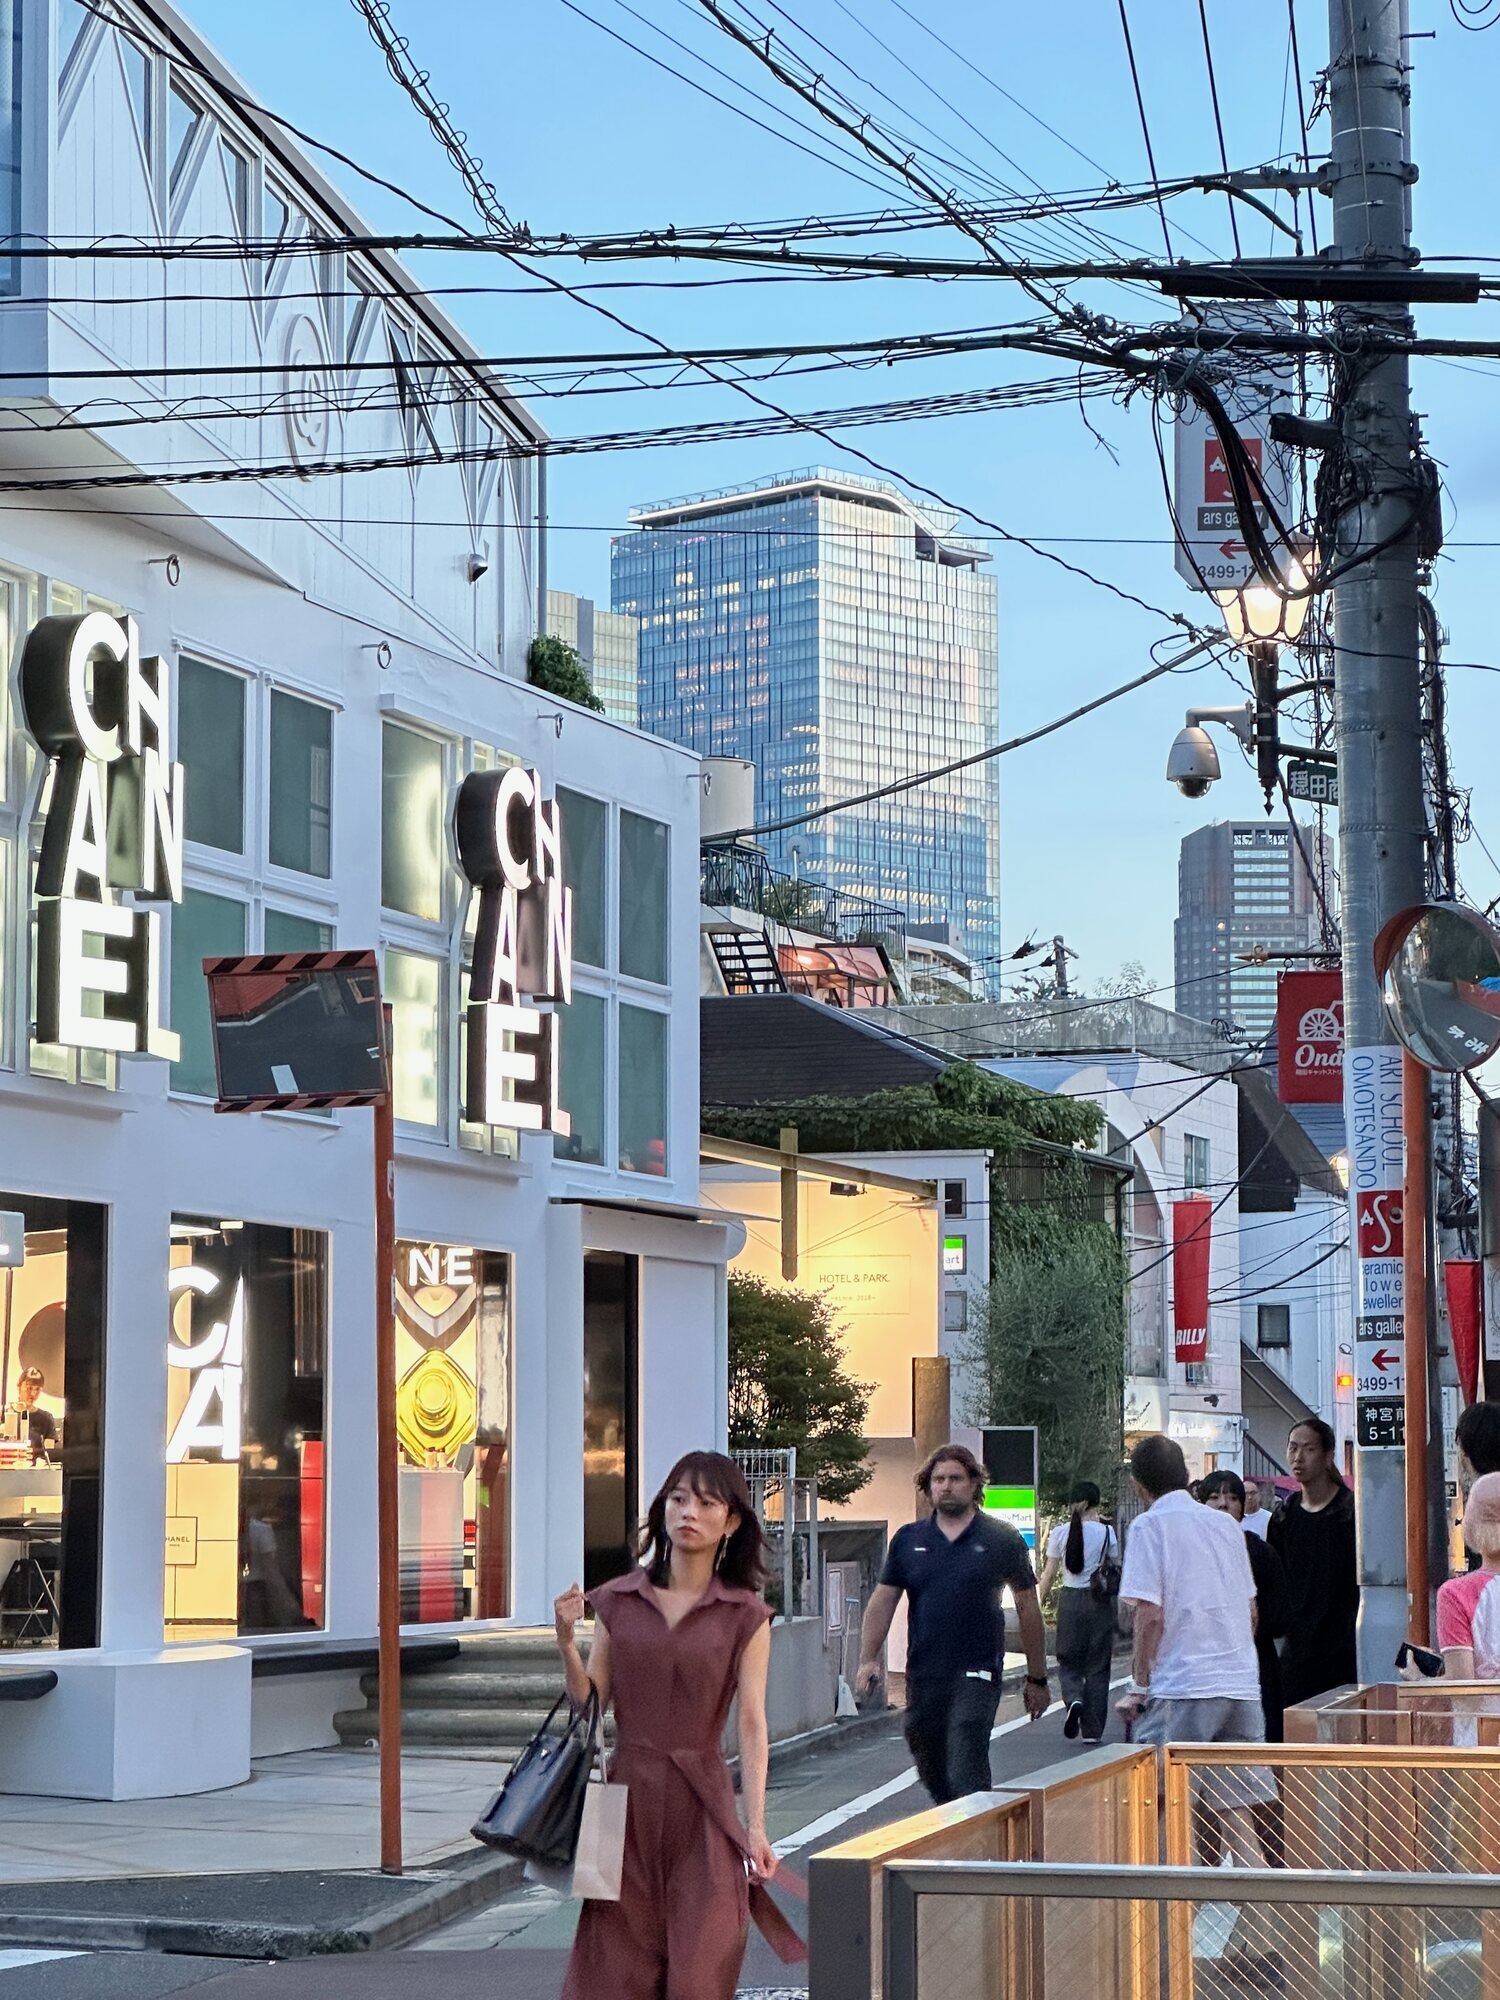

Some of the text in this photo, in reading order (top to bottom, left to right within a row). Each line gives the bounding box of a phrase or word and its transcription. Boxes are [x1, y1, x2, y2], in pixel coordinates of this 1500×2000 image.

[1203, 512, 1221, 525] ars
[1352, 1055, 1378, 1189] OMOTESANDO
[1380, 1093, 1403, 1172] SCHOOL
[1361, 1258, 1404, 1276] eramic
[819, 1274, 852, 1284] HOTEL
[853, 1273, 861, 1283] &
[1176, 1328, 1207, 1346] BILLY
[1359, 1317, 1405, 1339] ars galle
[1357, 1376, 1405, 1392] 3499-1
